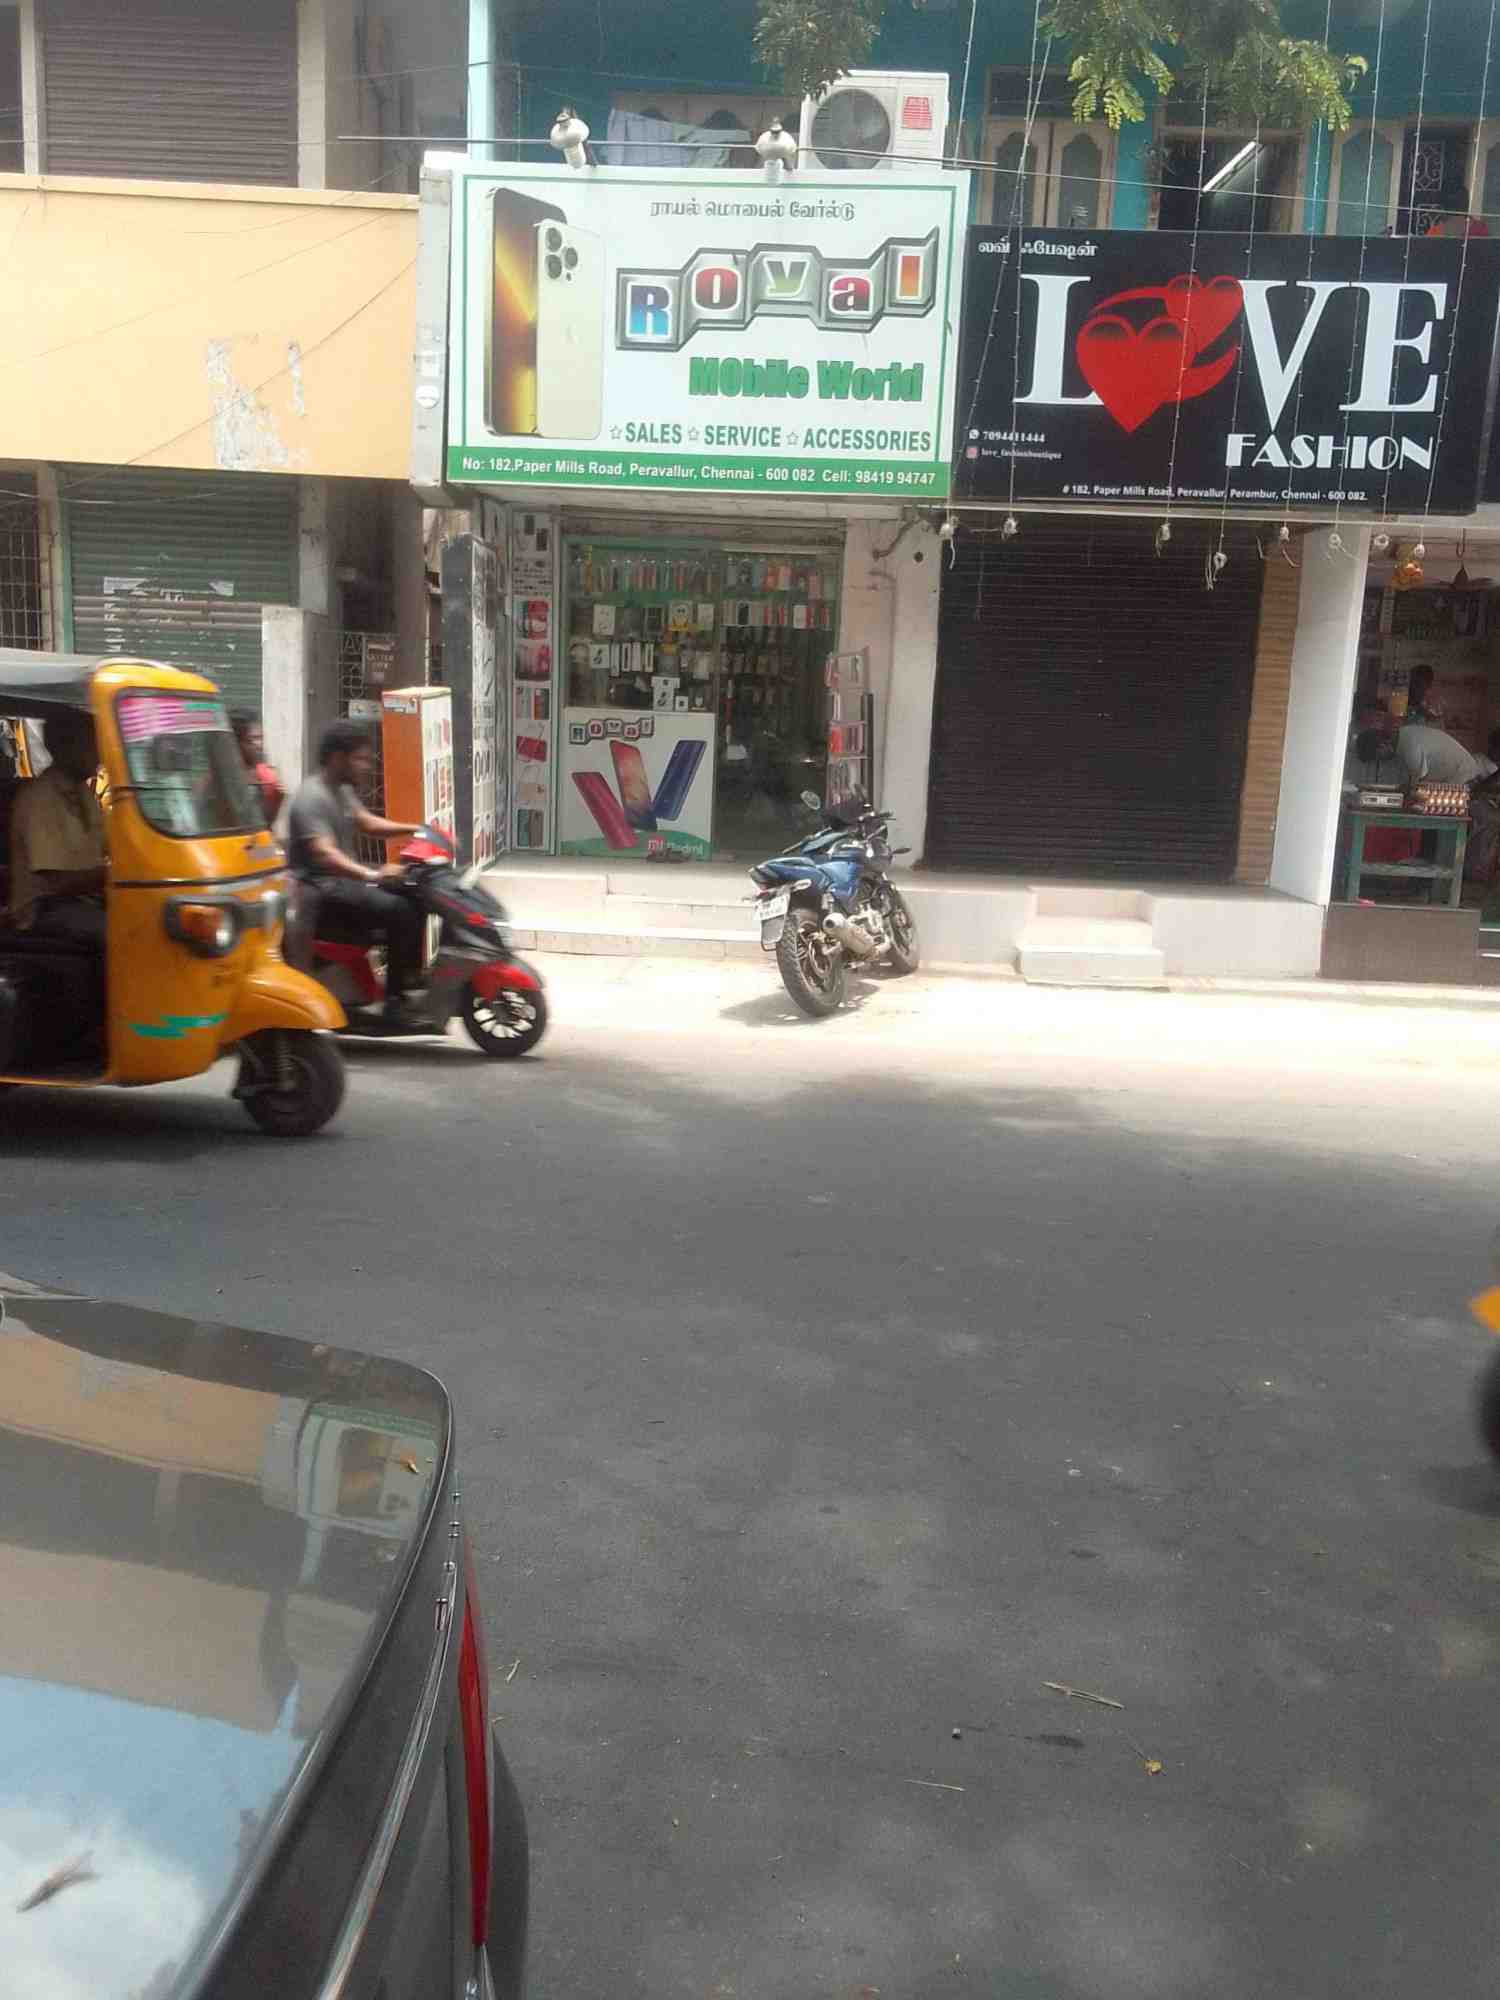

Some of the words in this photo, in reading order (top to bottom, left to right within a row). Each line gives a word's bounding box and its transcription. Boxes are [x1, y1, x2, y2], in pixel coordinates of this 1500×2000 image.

[650, 198, 699, 217] ராயல்
[817, 360, 924, 401] World
[625, 422, 682, 444] SALES
[703, 425, 782, 447] SERVICE
[803, 428, 931, 451] ACCESSORIES
[1225, 434, 1434, 470] FASHION
[462, 457, 485, 470] No:
[555, 460, 585, 475] Mills
[589, 461, 625, 477] Road,
[630, 462, 697, 480] Peravallur,
[701, 466, 754, 480] Chennai
[765, 467, 788, 481] 600
[792, 468, 815, 482] 082
[823, 469, 851, 483] Cell:
[855, 470, 893, 484] 98419
[896, 471, 936, 485] 94747
[1094, 486, 1121, 497] Paper
[1123, 486, 1146, 496] Mills
[1281, 489, 1320, 500] Chennai
[1328, 490, 1346, 500] 600
